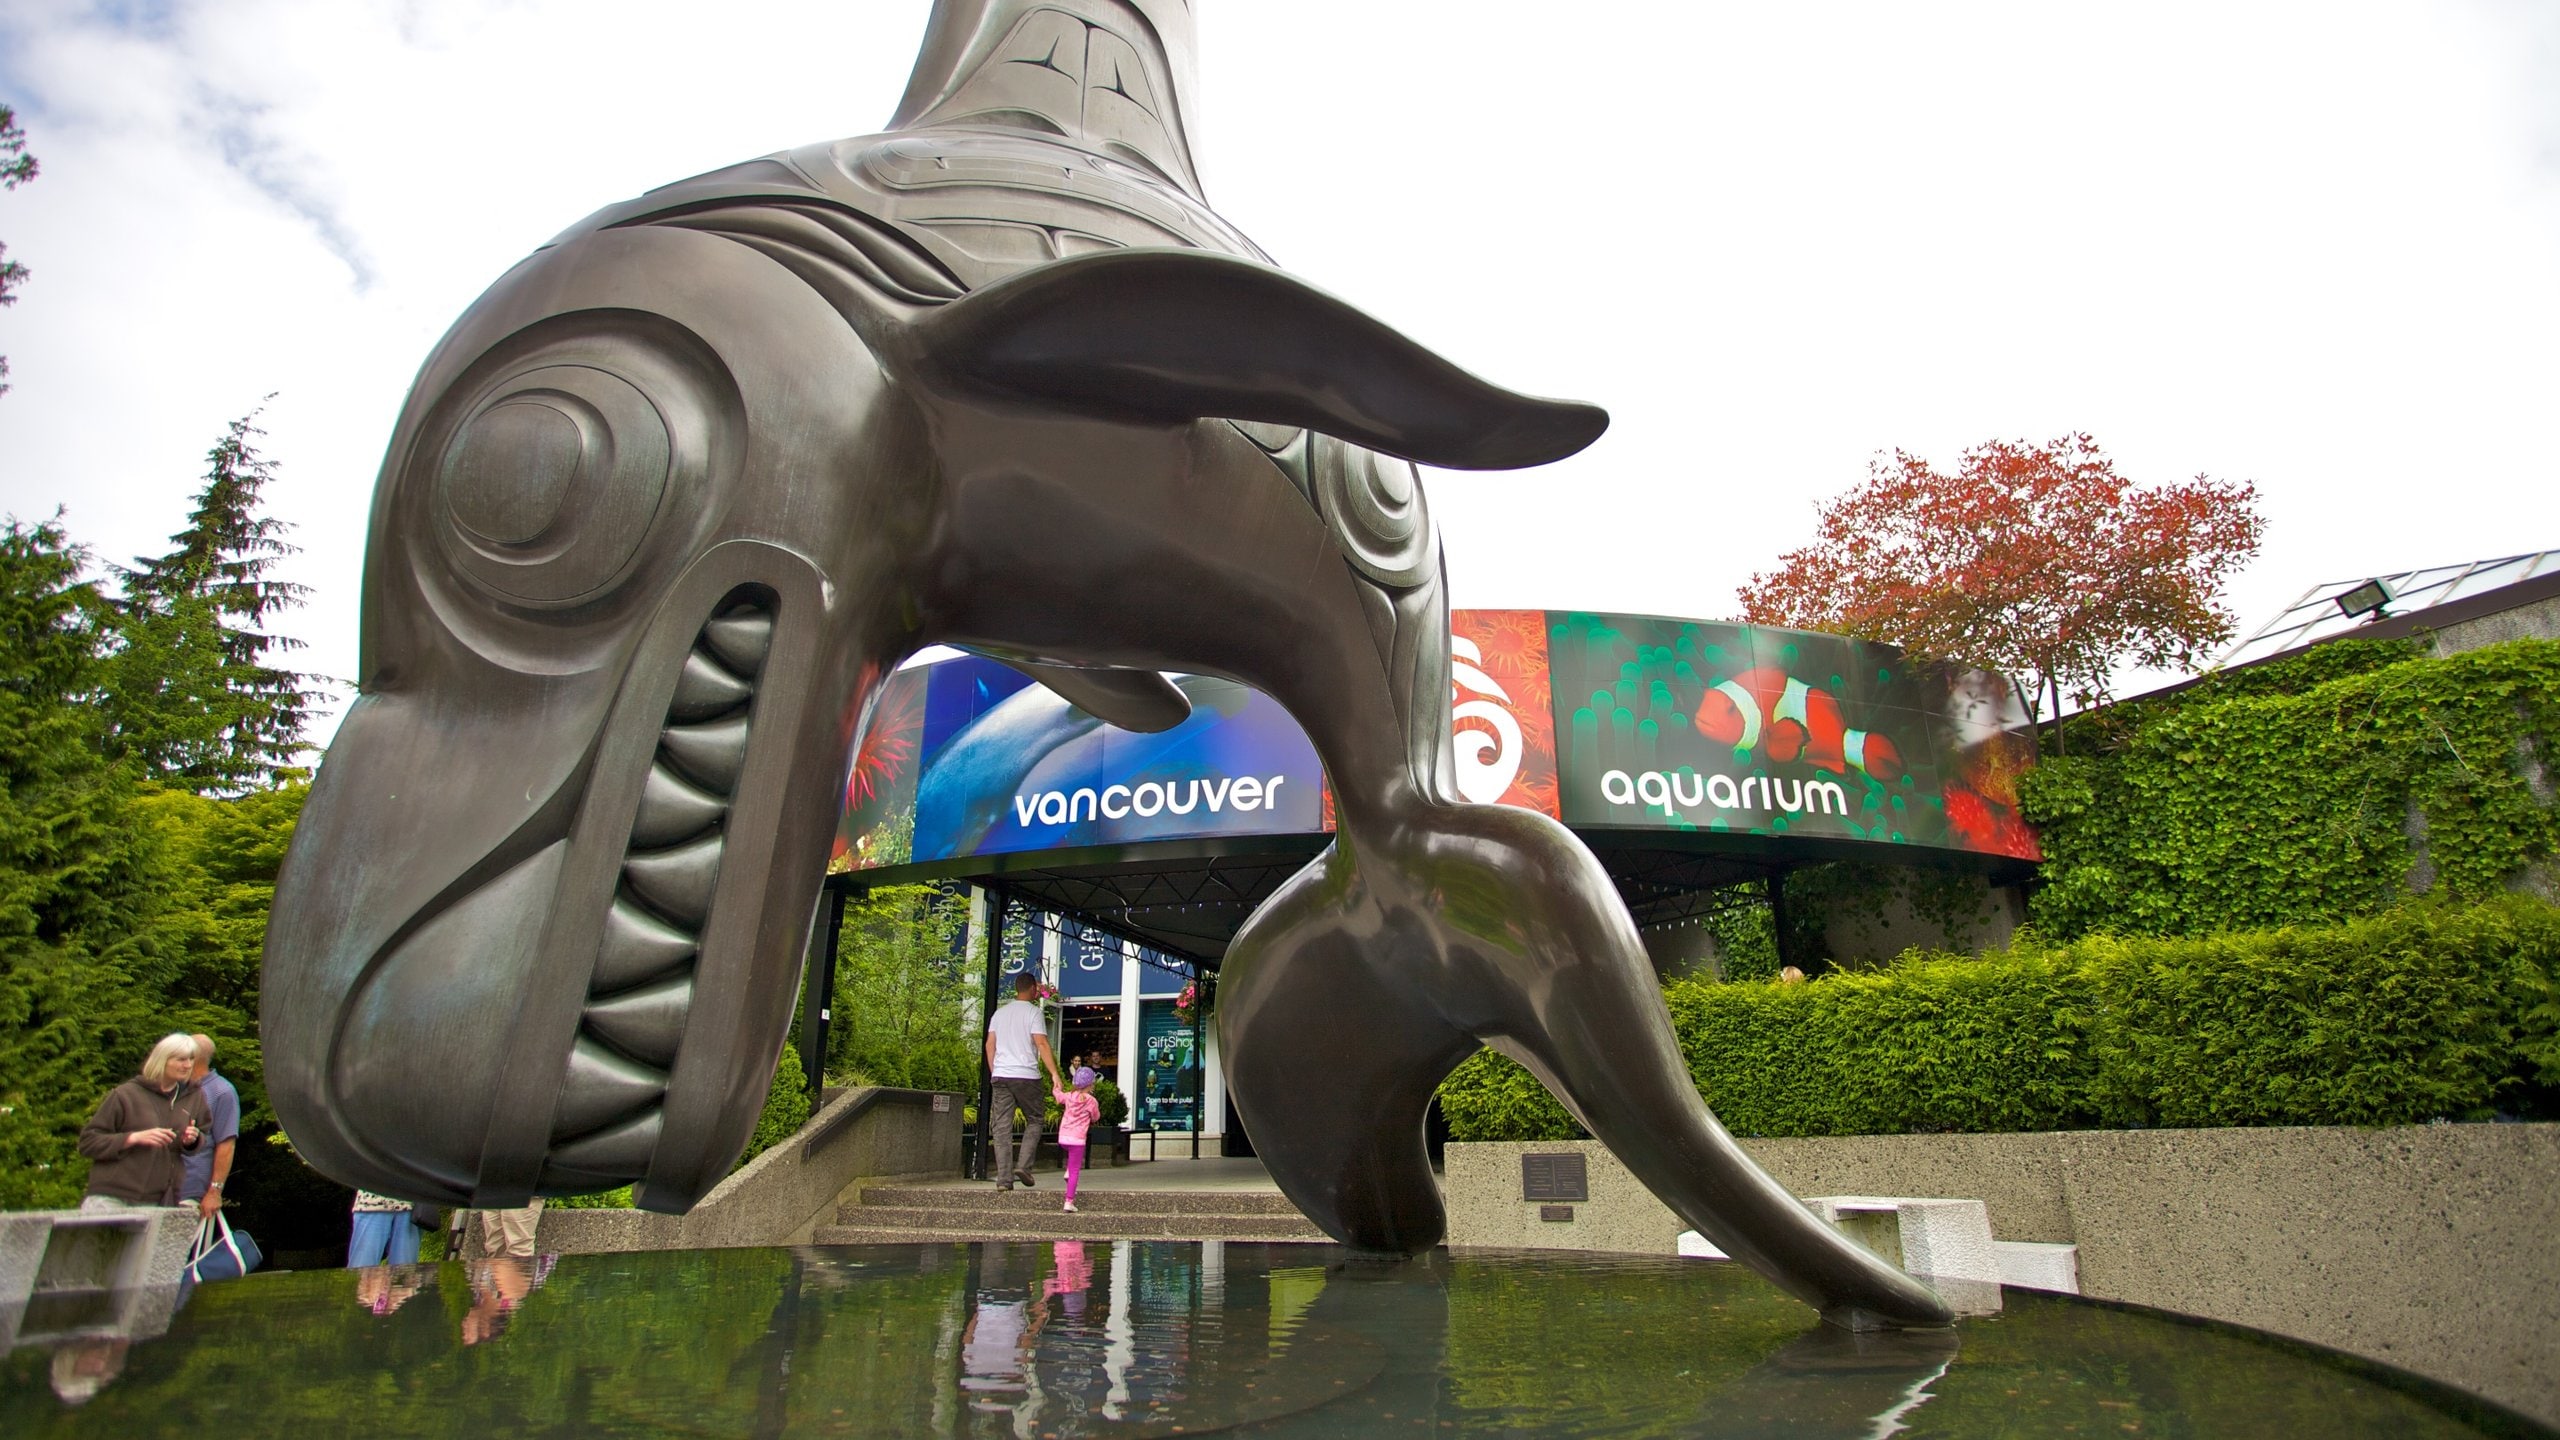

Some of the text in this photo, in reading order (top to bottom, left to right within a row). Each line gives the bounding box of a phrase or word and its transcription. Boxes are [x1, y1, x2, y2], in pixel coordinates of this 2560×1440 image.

[1015, 775, 1284, 827] vancouver
[1601, 770, 1848, 816] aquarium
[1145, 1096, 1161, 1104] Open
[1179, 1096, 1194, 1105] publi
